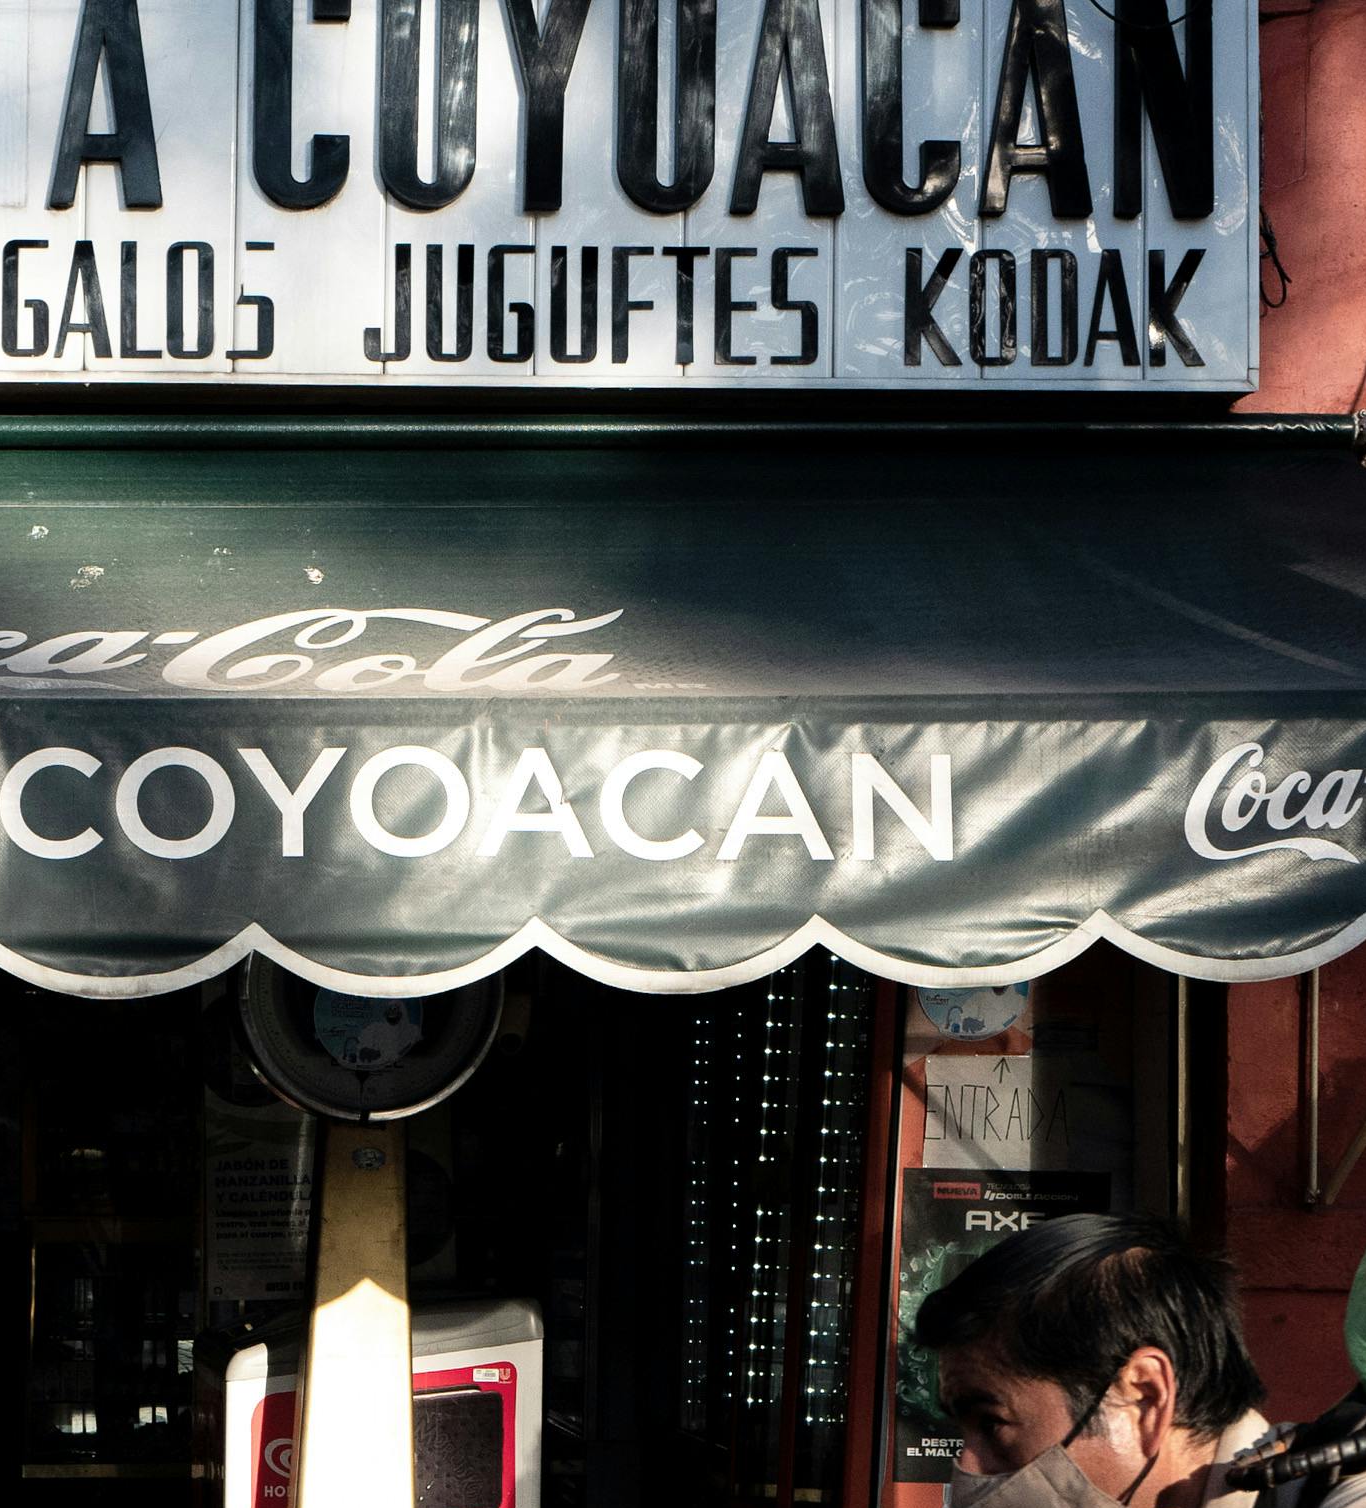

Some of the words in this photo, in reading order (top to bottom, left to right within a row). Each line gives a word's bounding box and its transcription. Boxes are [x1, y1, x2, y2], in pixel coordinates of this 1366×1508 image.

[251, 0, 1215, 220] COYOACAN
[903, 248, 1207, 368] KODAK
[923, 1084, 1071, 1145] ENTRADA
[269, 1159, 289, 1170] DE
[965, 1209, 1046, 1232] AXE
[906, 1447, 923, 1457] EL
[925, 1448, 953, 1457] MAL
